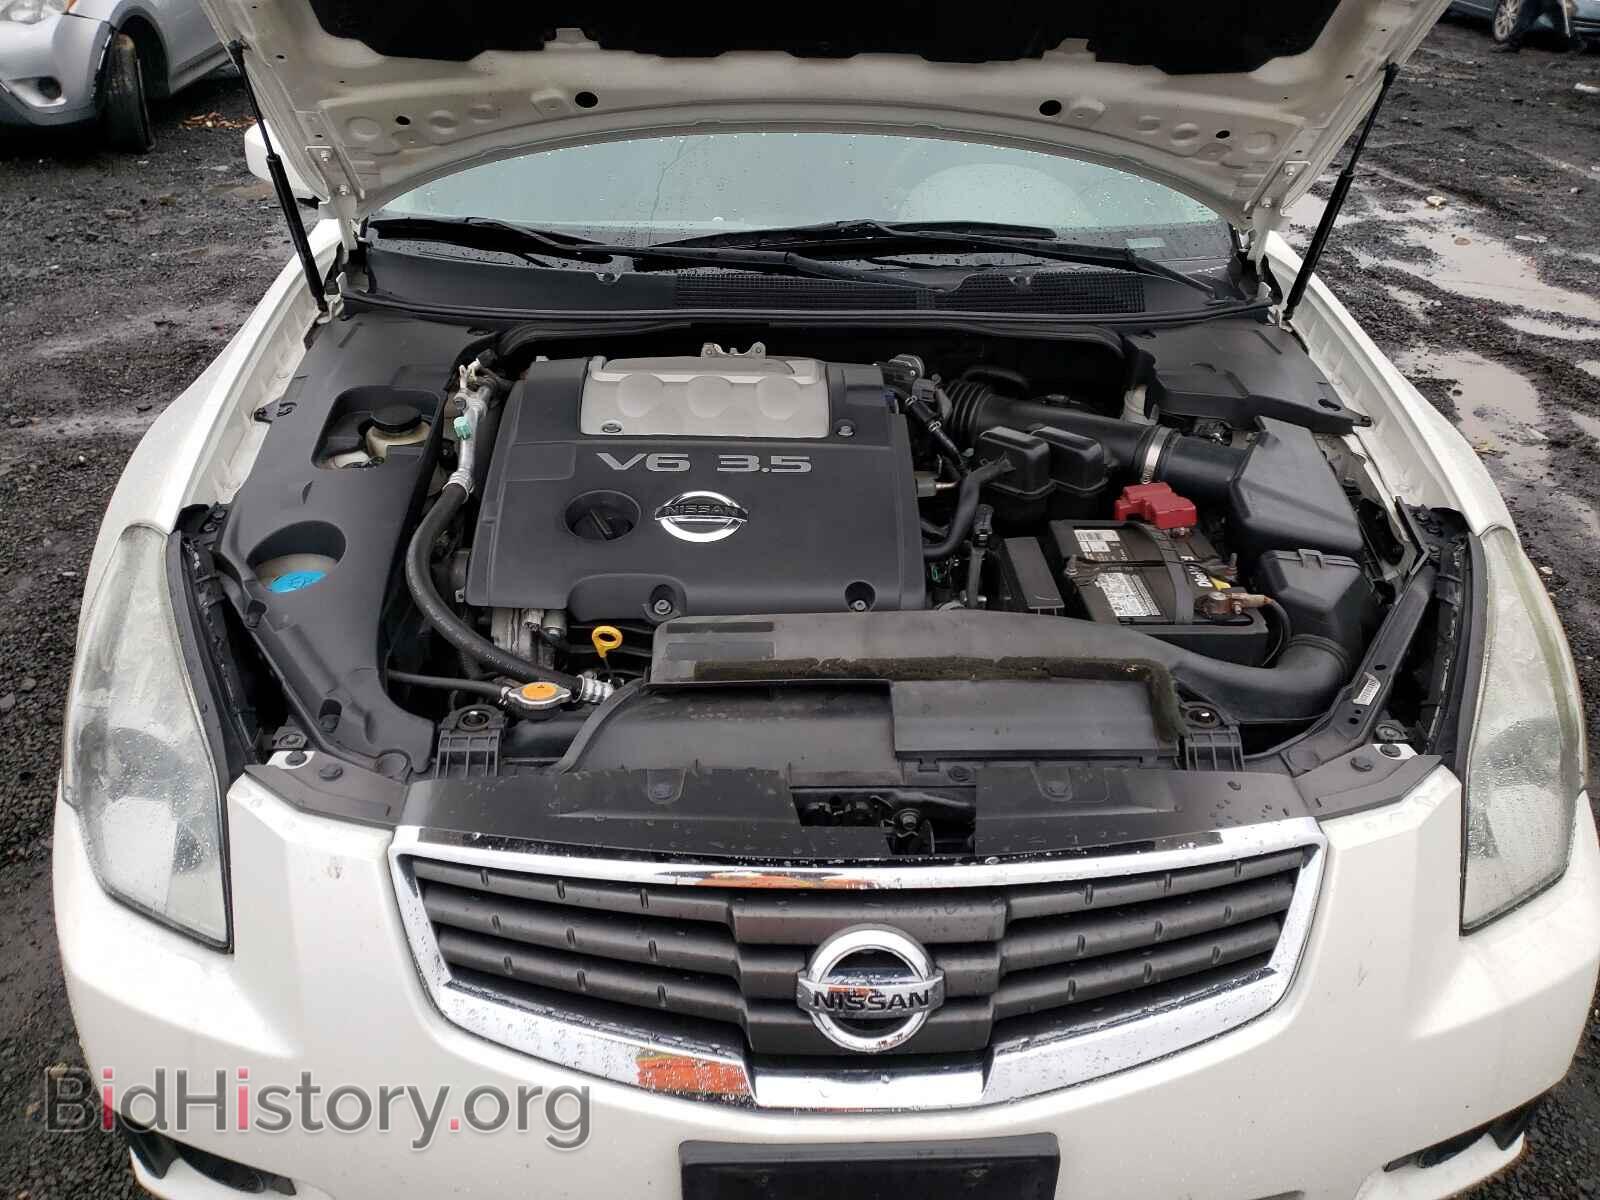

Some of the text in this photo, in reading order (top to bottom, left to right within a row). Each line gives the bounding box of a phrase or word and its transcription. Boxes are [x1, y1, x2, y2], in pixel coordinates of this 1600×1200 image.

[596, 452, 812, 473] V6 3.5
[664, 504, 739, 516] NISSAN
[814, 989, 929, 1010] NISSAN
